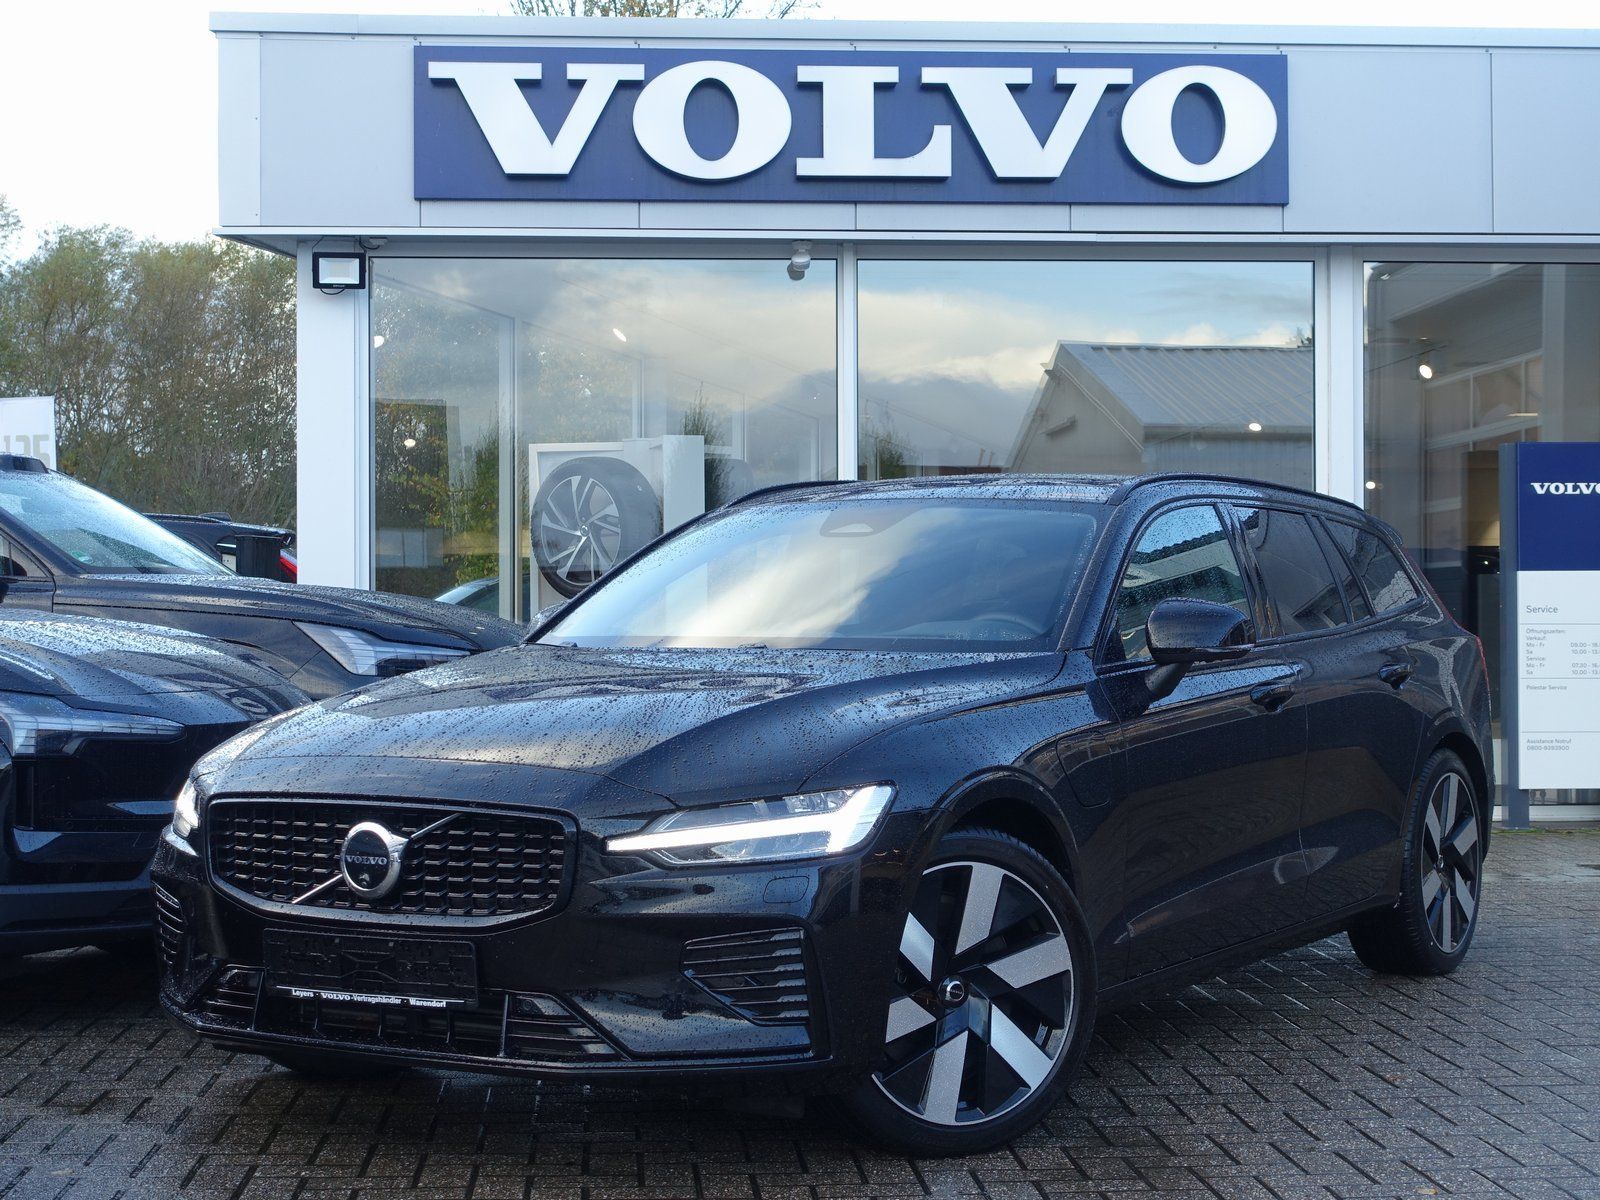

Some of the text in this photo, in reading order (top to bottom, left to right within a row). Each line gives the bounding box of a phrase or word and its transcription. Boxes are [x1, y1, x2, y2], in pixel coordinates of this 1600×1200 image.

[428, 60, 1279, 184] VOLVO
[1526, 605, 1559, 614] Service
[345, 854, 388, 866] VOLVO
[292, 988, 314, 998] Leyers
[409, 998, 447, 1008] Warendorf
